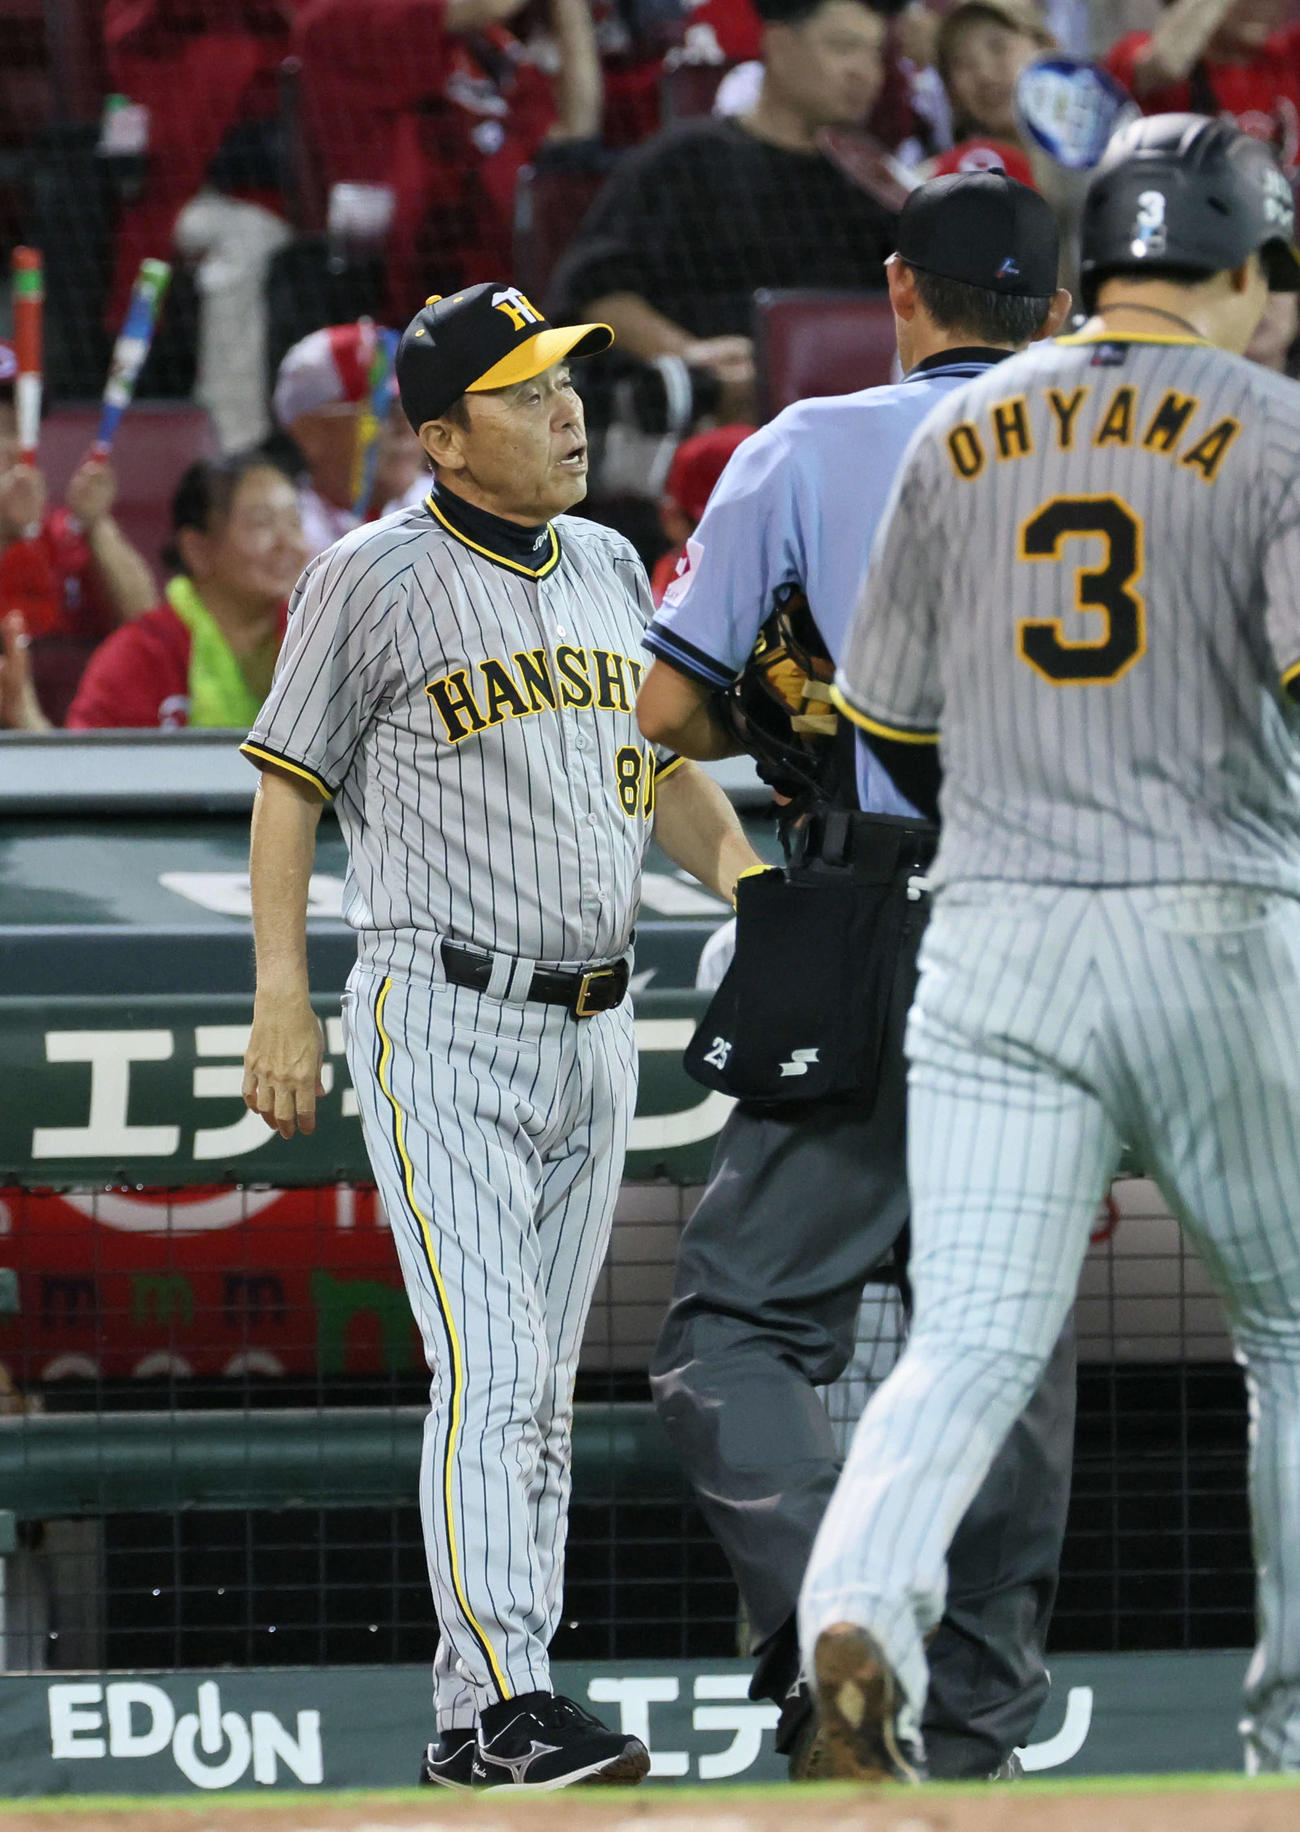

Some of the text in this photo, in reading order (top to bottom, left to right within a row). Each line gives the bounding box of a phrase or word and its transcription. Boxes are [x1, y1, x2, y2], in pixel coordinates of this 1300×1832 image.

[1137, 190, 1166, 227] 3
[947, 383, 1242, 485] OHYAMA
[1016, 493, 1147, 687] 3
[425, 643, 648, 743] HANSHI
[703, 1036, 732, 1070] 25
